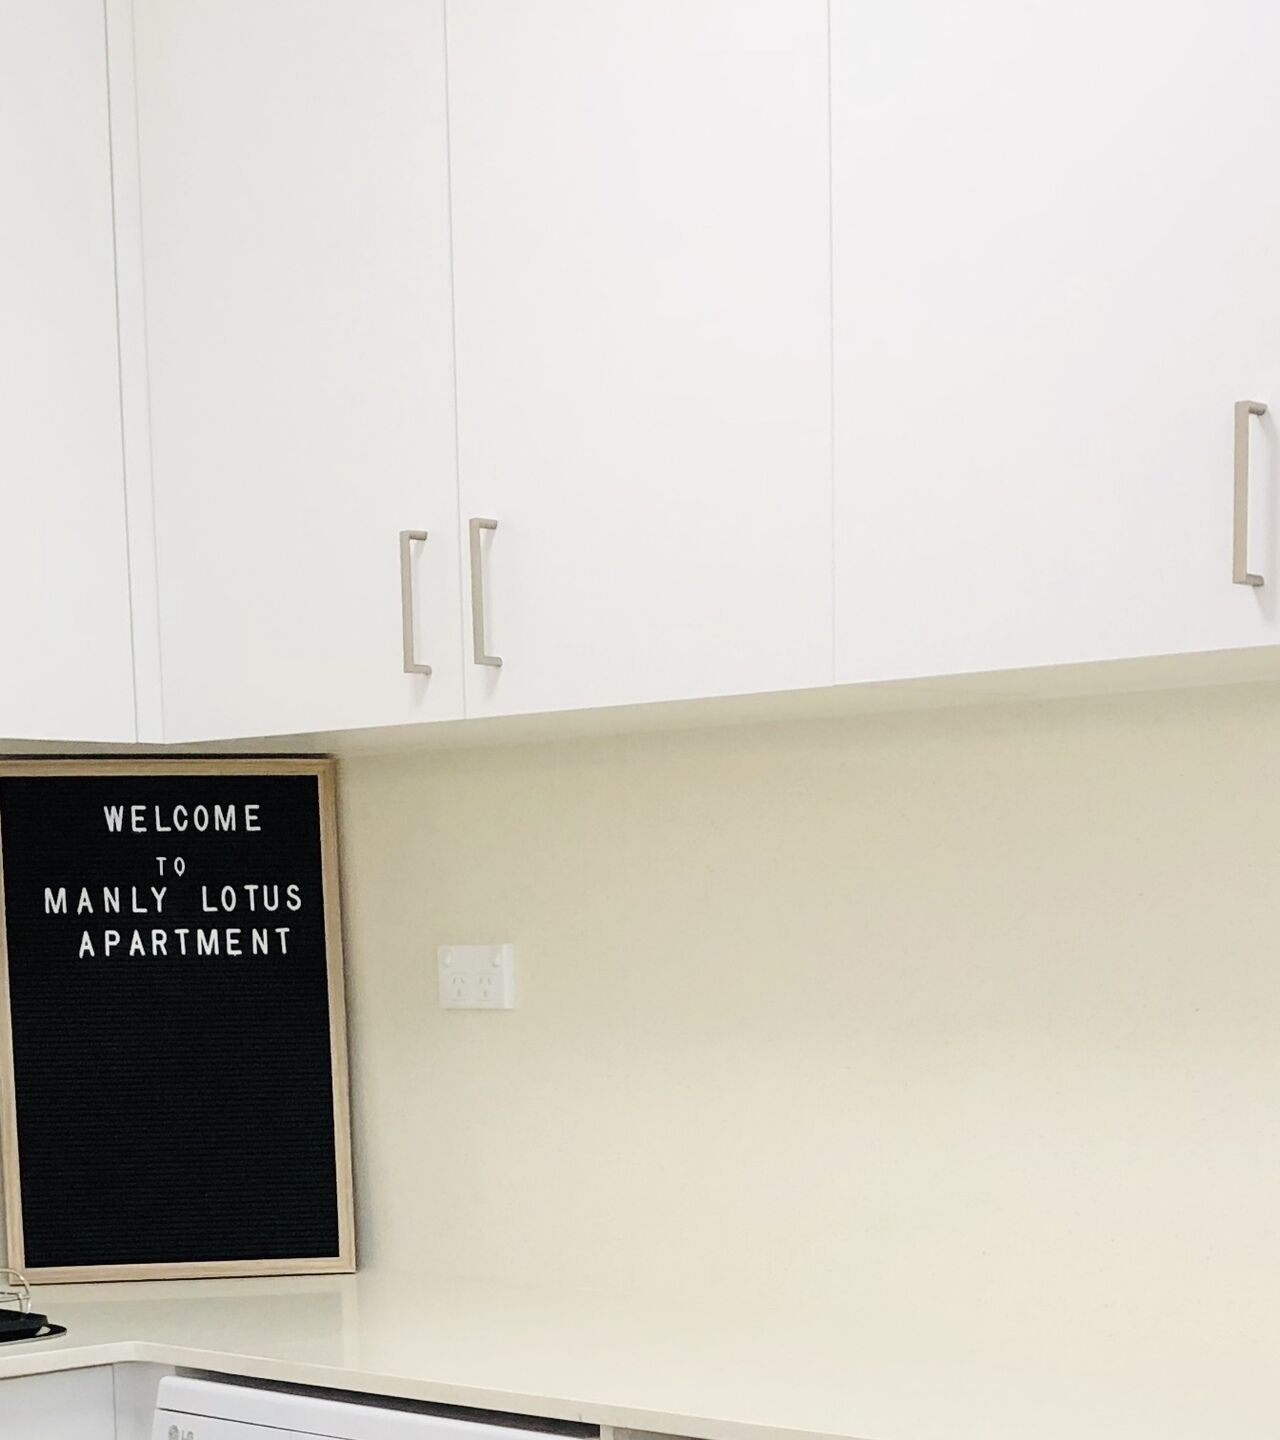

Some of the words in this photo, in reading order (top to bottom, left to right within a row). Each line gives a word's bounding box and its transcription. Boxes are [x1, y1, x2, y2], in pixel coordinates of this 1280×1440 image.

[103, 804, 262, 833] WELCOME
[155, 856, 186, 877] TO
[44, 886, 167, 915] MANLY
[202, 883, 303, 913] LOTUS
[78, 927, 291, 959] APARTMENT
